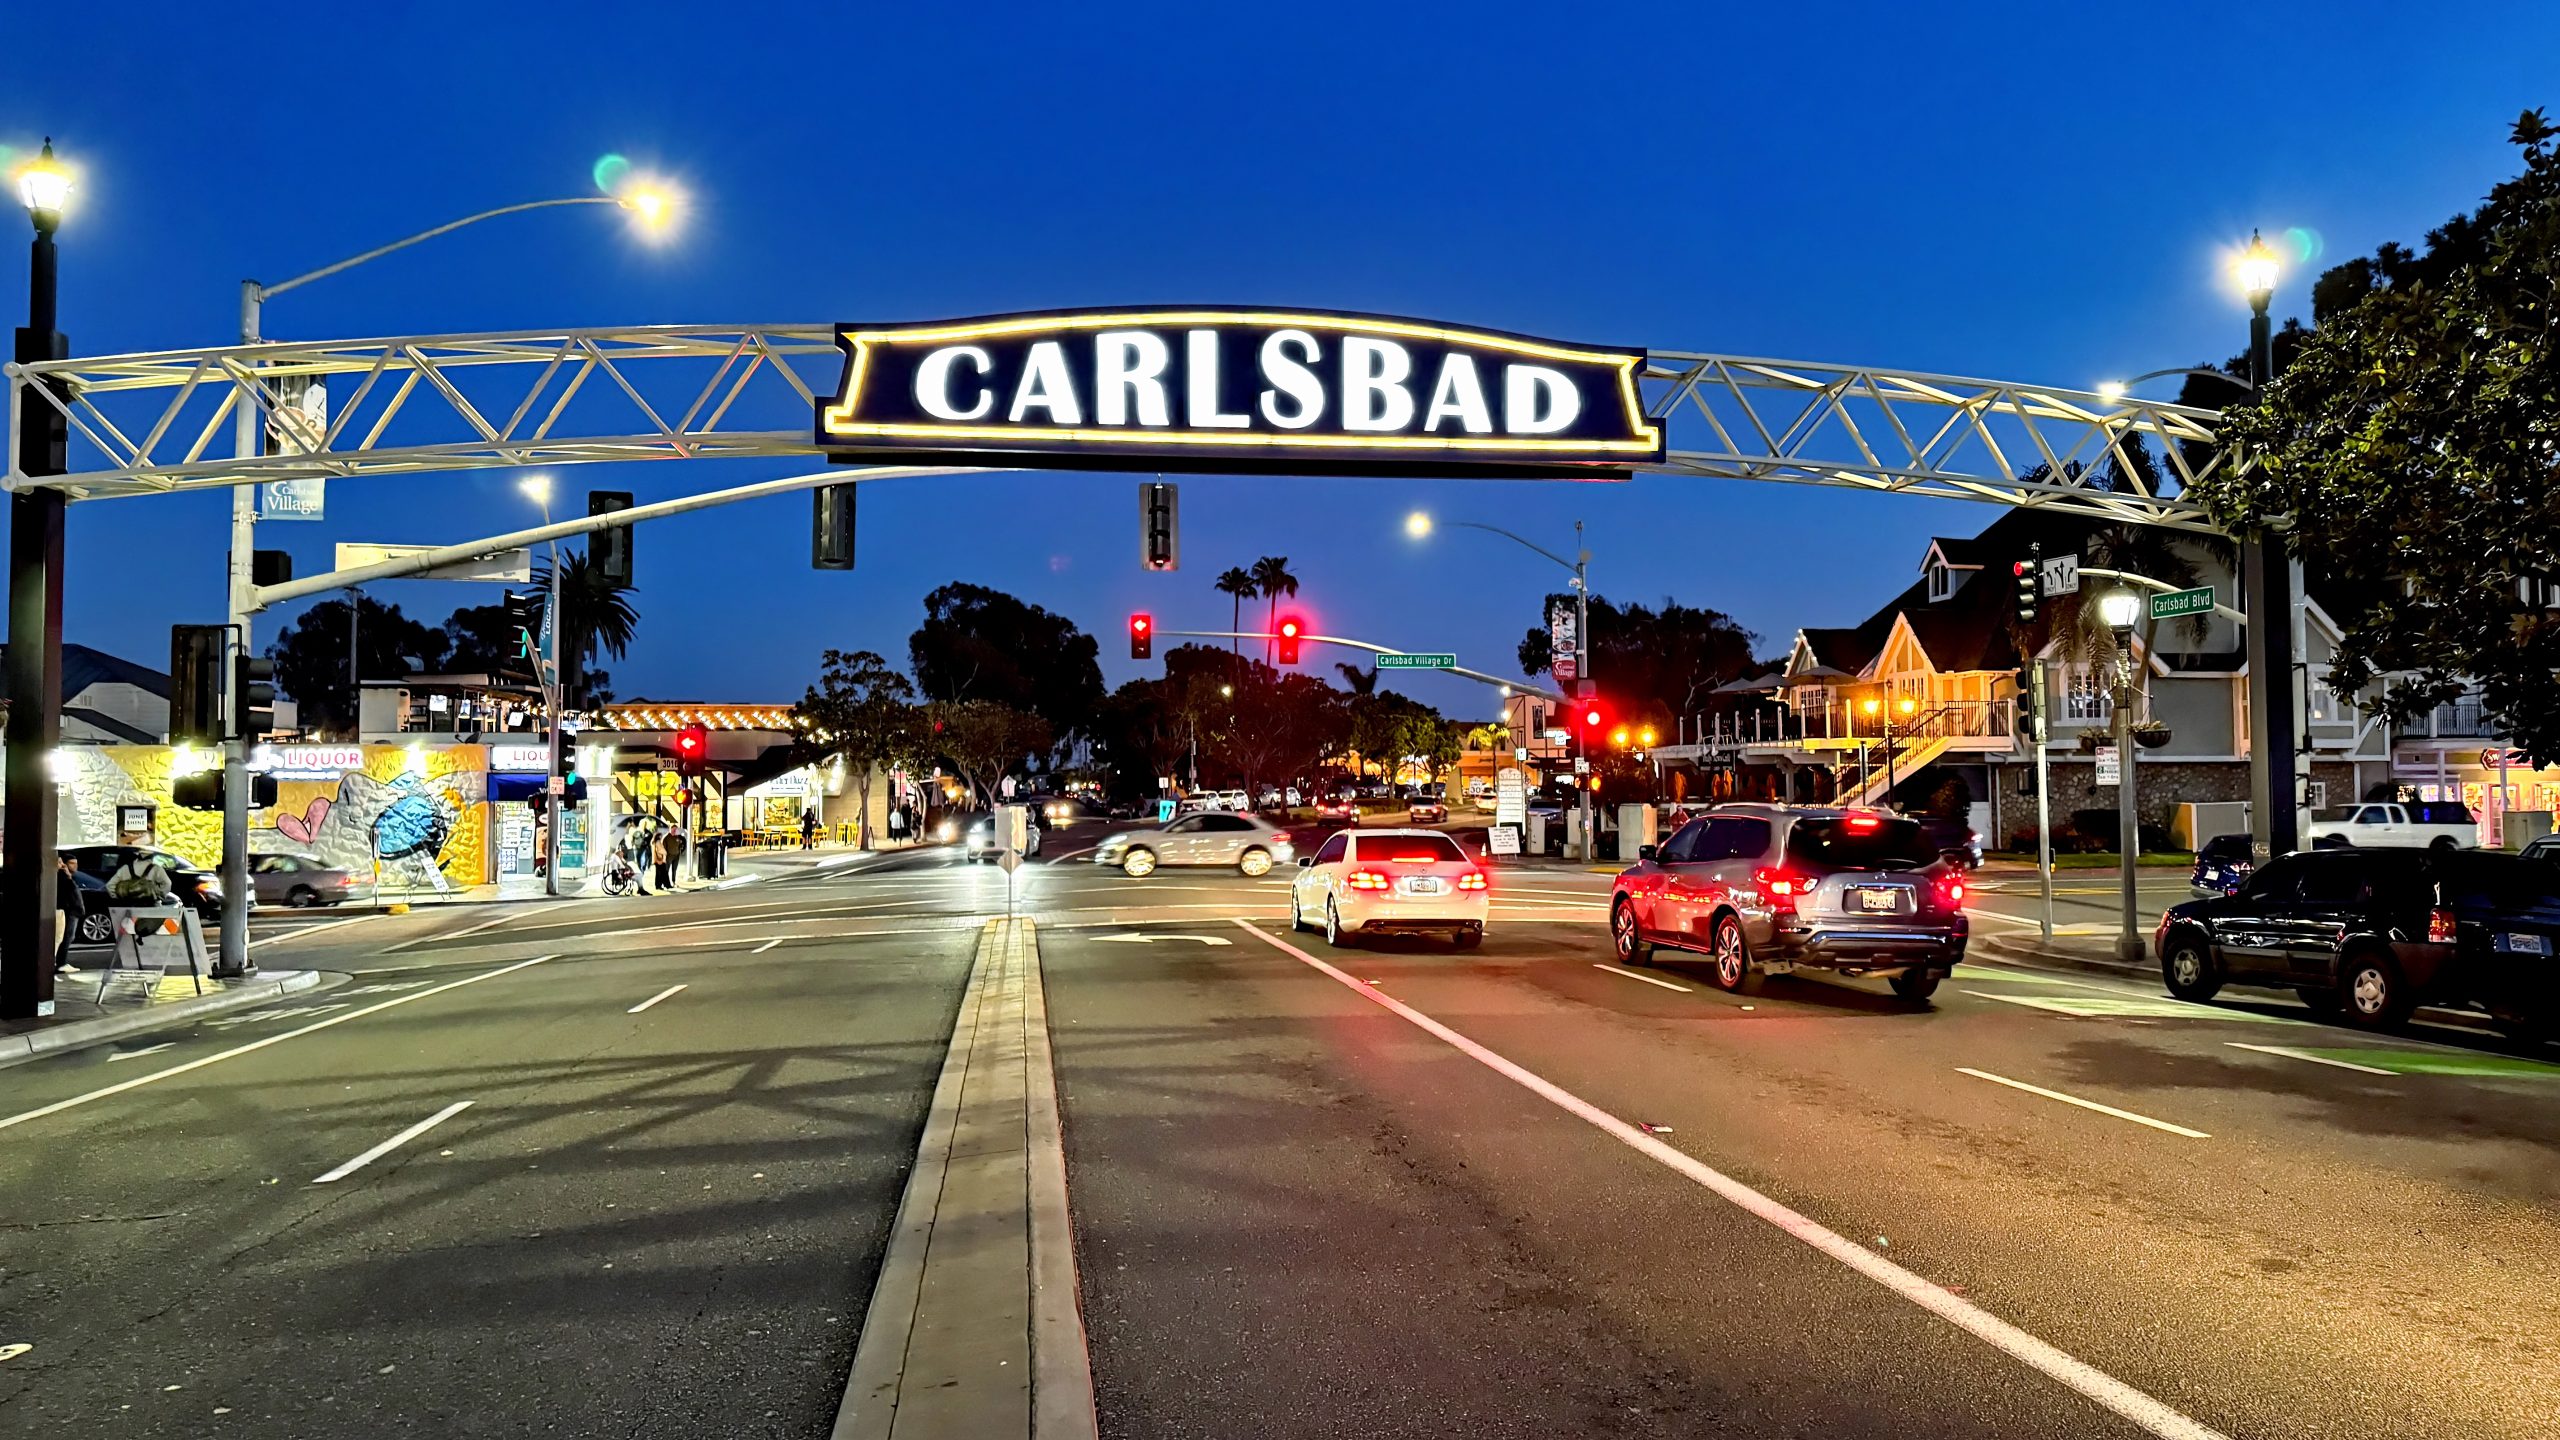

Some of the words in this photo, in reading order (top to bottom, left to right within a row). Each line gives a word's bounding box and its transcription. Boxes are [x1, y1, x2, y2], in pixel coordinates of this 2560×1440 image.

[913, 328, 1582, 434] CARLSBAD
[267, 496, 319, 515] Village
[2154, 595, 2189, 613] Carlsbad
[2192, 592, 2210, 607] Blvd
[1380, 656, 1413, 665] Carlsbad
[1415, 656, 1441, 667] Village
[1443, 656, 1452, 665] Dr
[288, 752, 360, 767] LIQUOR
[514, 751, 551, 761] LIQU
